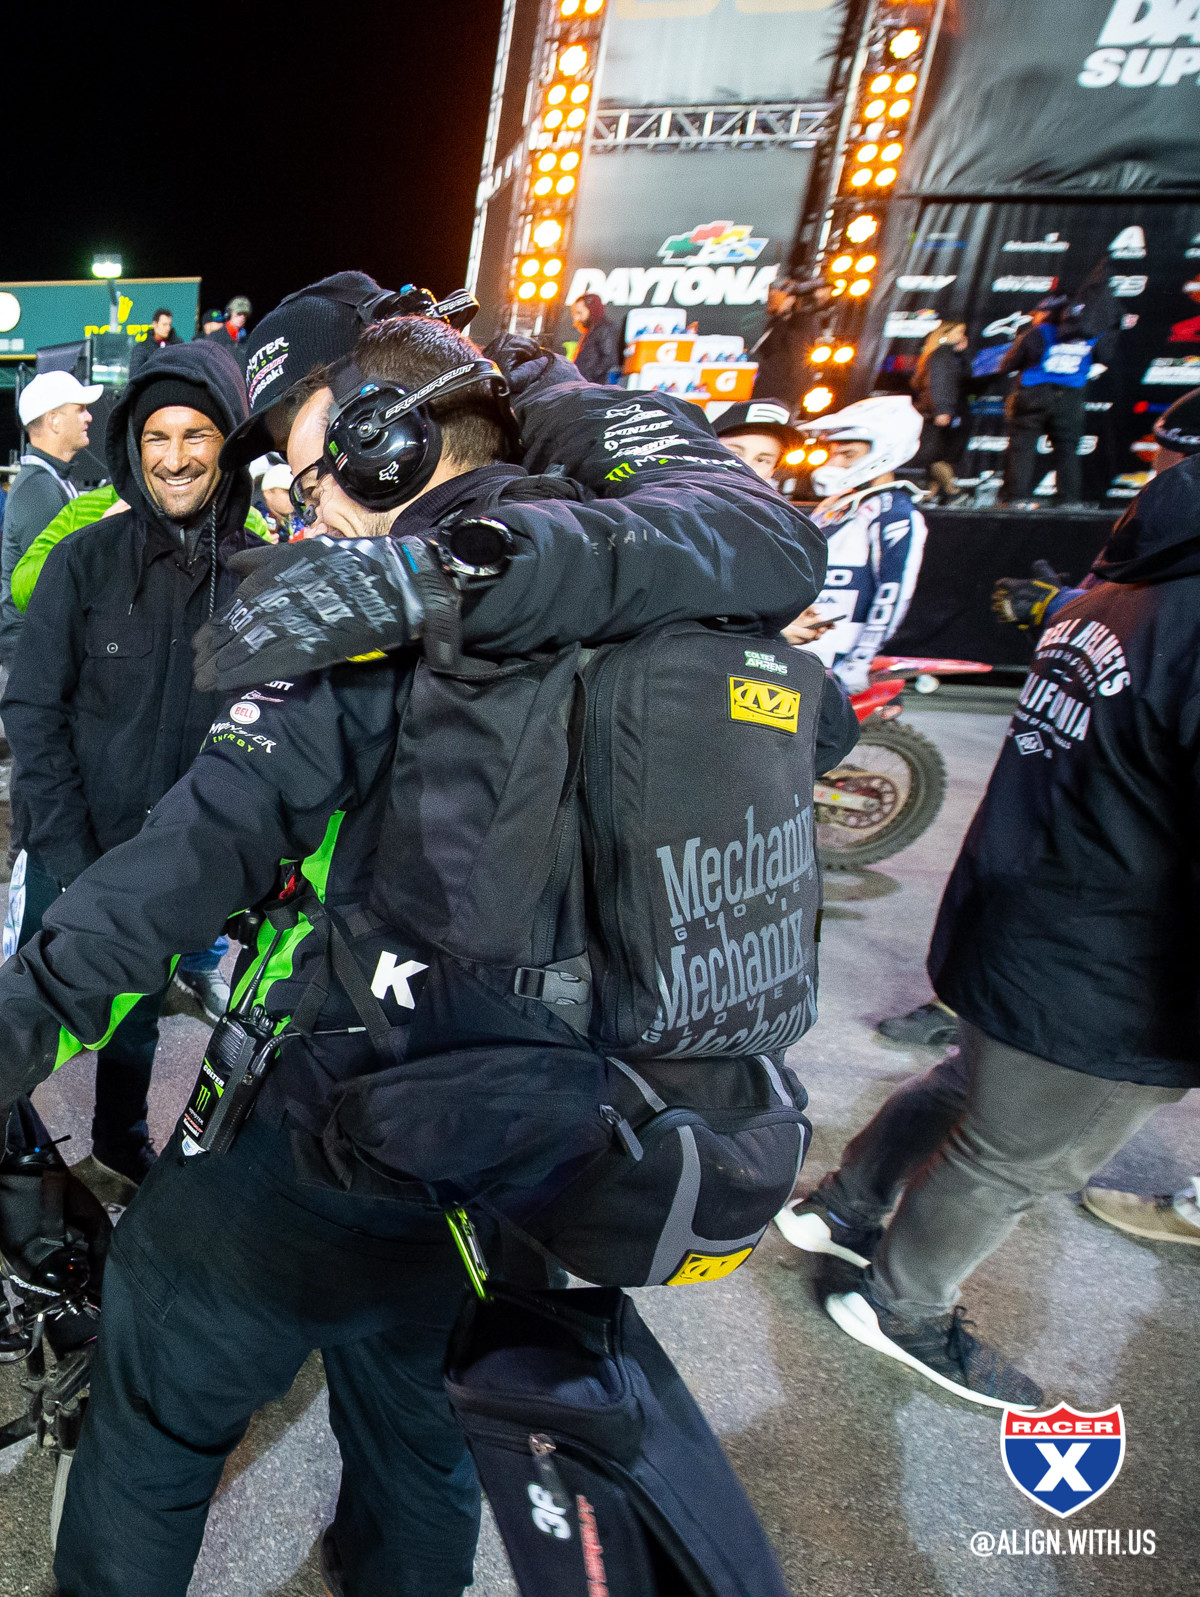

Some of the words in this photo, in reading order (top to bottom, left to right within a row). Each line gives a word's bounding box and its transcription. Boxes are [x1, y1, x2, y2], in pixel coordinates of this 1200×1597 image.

[1078, 48, 1200, 88] SUP
[565, 262, 781, 306] DAYTONA
[656, 342, 678, 363] G
[385, 394, 417, 419] PRO
[418, 363, 475, 399] CIRCUIT
[715, 371, 738, 393] G
[1035, 618, 1081, 652] BELL
[1069, 621, 1131, 697] HELMETS
[234, 706, 254, 719] BELL
[656, 794, 815, 927] Mechanix
[371, 950, 430, 1010] K
[653, 898, 806, 1031] Mechanix
[203, 1064, 226, 1088] COLTER
